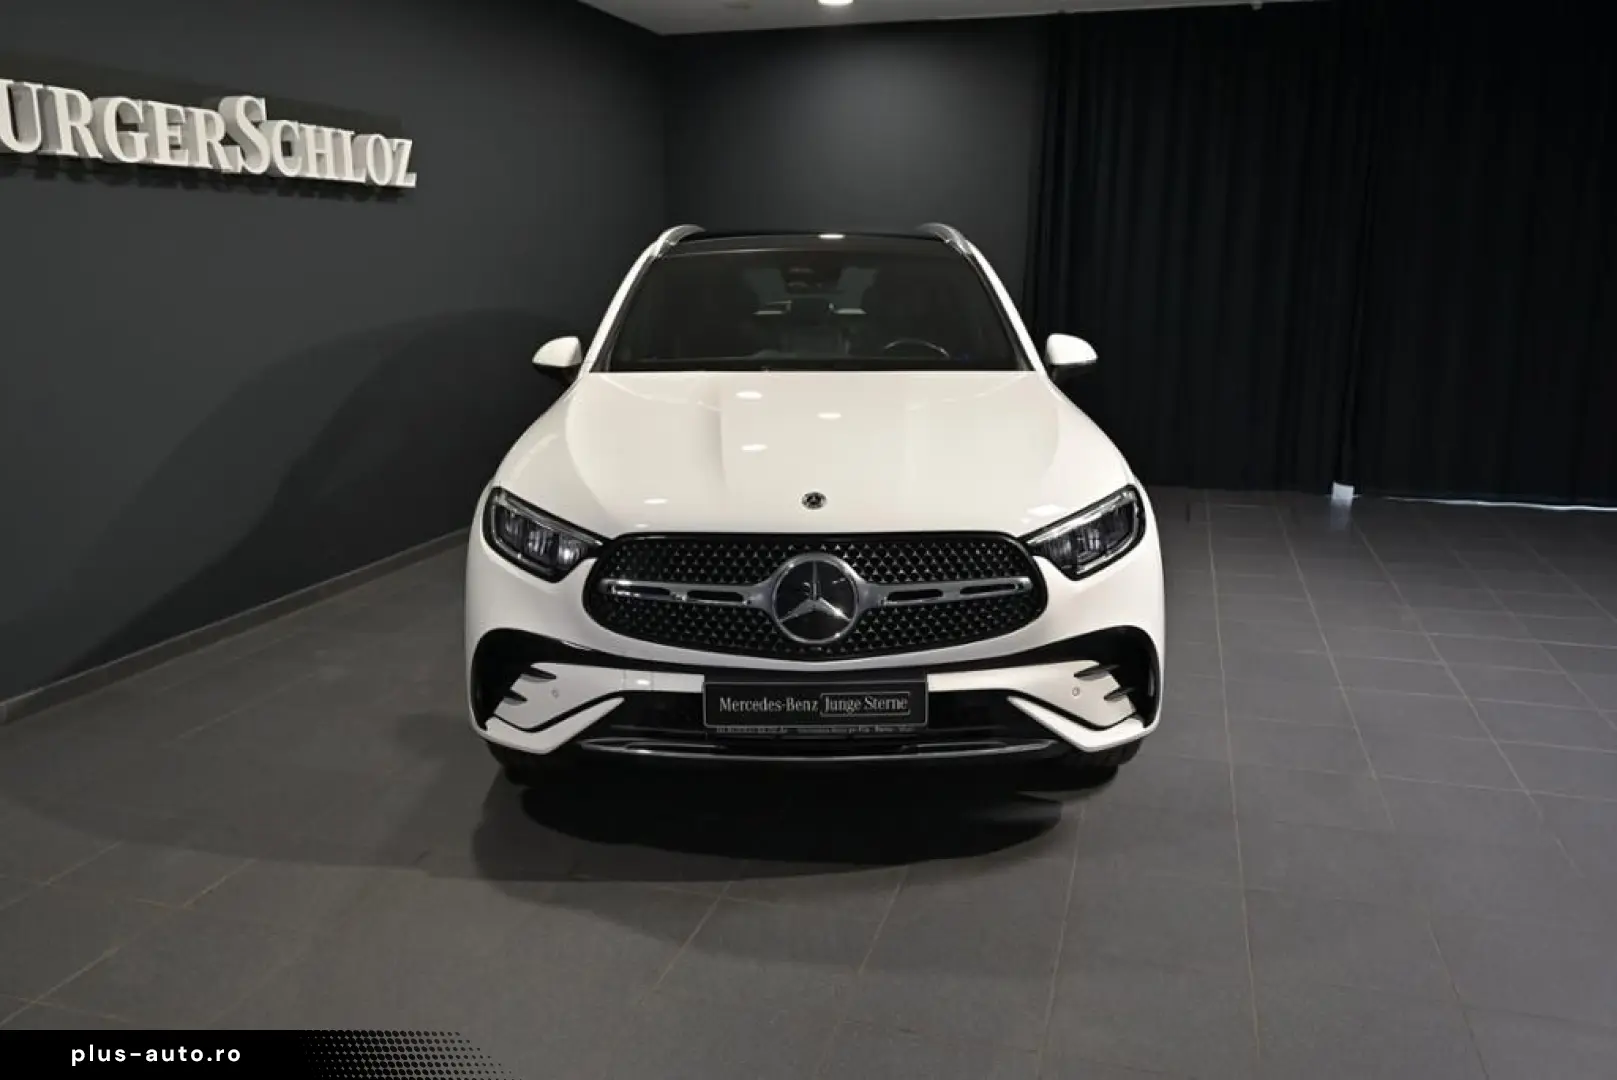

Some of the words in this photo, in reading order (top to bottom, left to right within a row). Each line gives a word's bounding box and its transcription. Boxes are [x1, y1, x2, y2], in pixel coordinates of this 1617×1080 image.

[719, 696, 818, 712] Mercedes-Benz
[825, 697, 861, 714] Junge
[864, 695, 908, 711] Sterne
